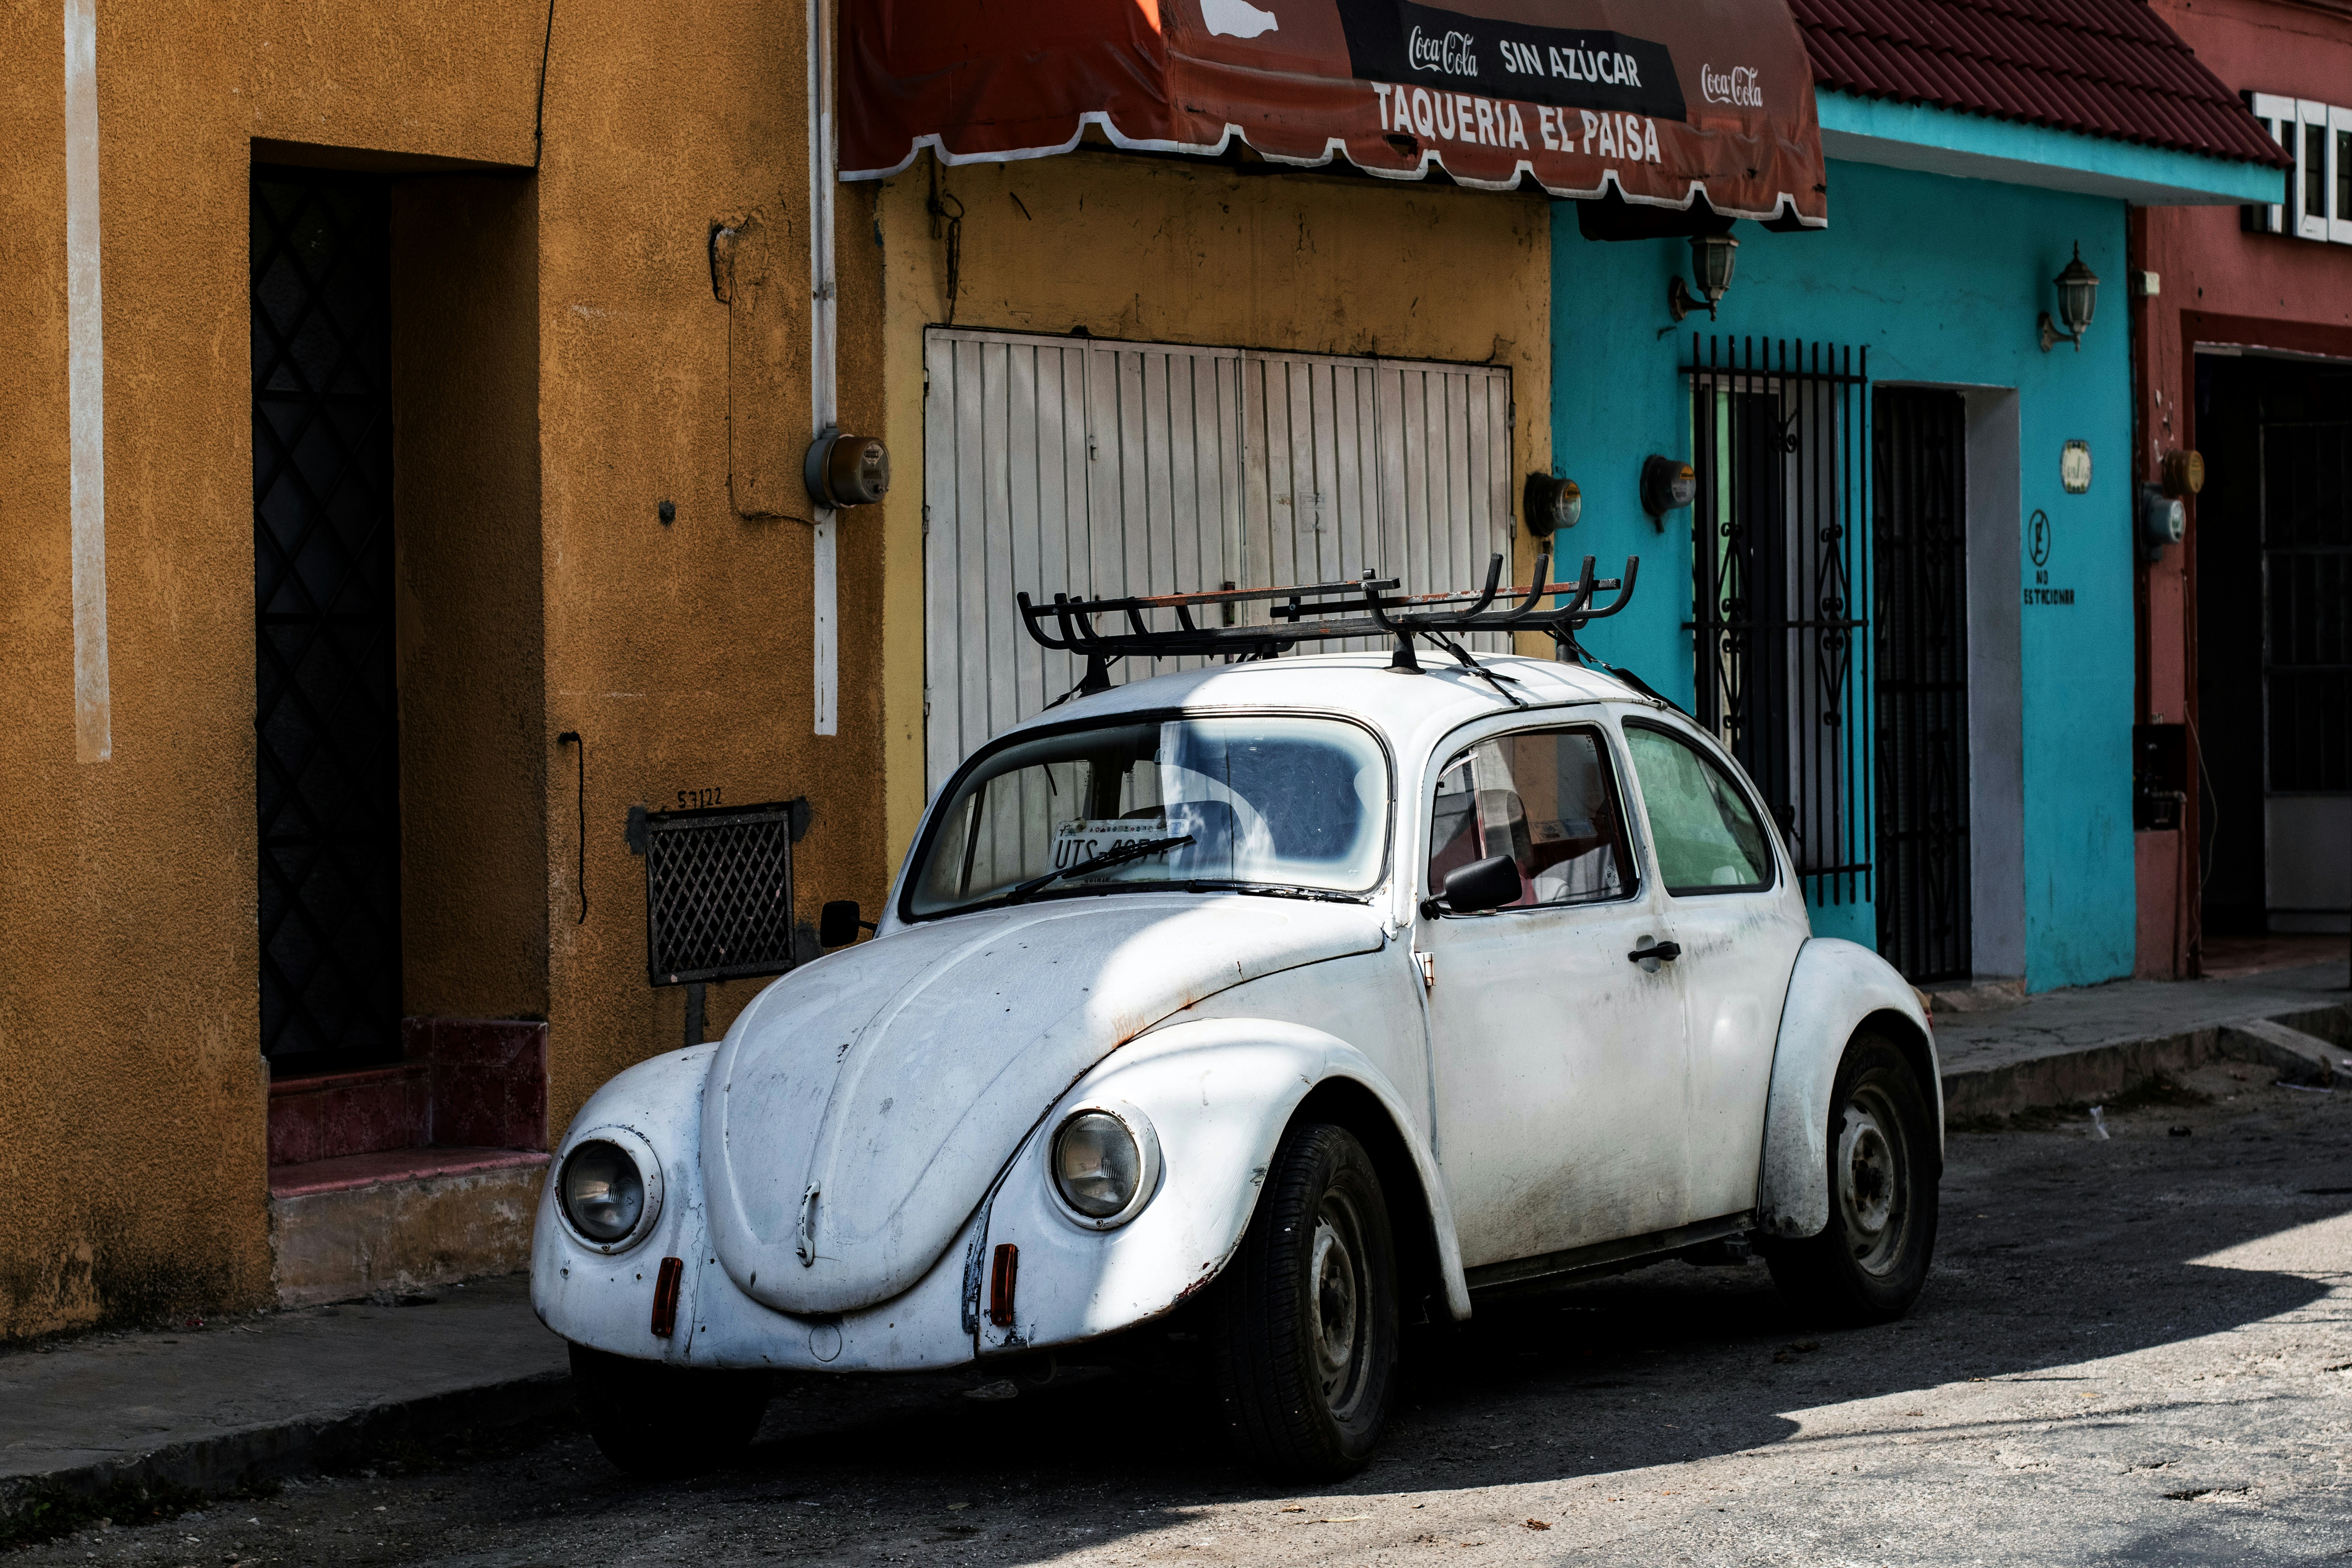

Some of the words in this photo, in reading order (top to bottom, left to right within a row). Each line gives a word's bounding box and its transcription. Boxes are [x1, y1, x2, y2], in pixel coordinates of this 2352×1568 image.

[1409, 25, 1478, 76] Coca-Cola
[1500, 40, 1544, 76] SIN
[1549, 40, 1642, 87] AZÚCAR
[1701, 63, 1763, 107] Coca-Cola
[1372, 82, 1530, 151] TAQUERIA
[1537, 105, 1574, 153] EL
[1580, 109, 1661, 164] PAISA
[2024, 588, 2074, 605] ESTACIONAR
[2036, 569, 2048, 585] NO
[678, 787, 722, 809] 57122
